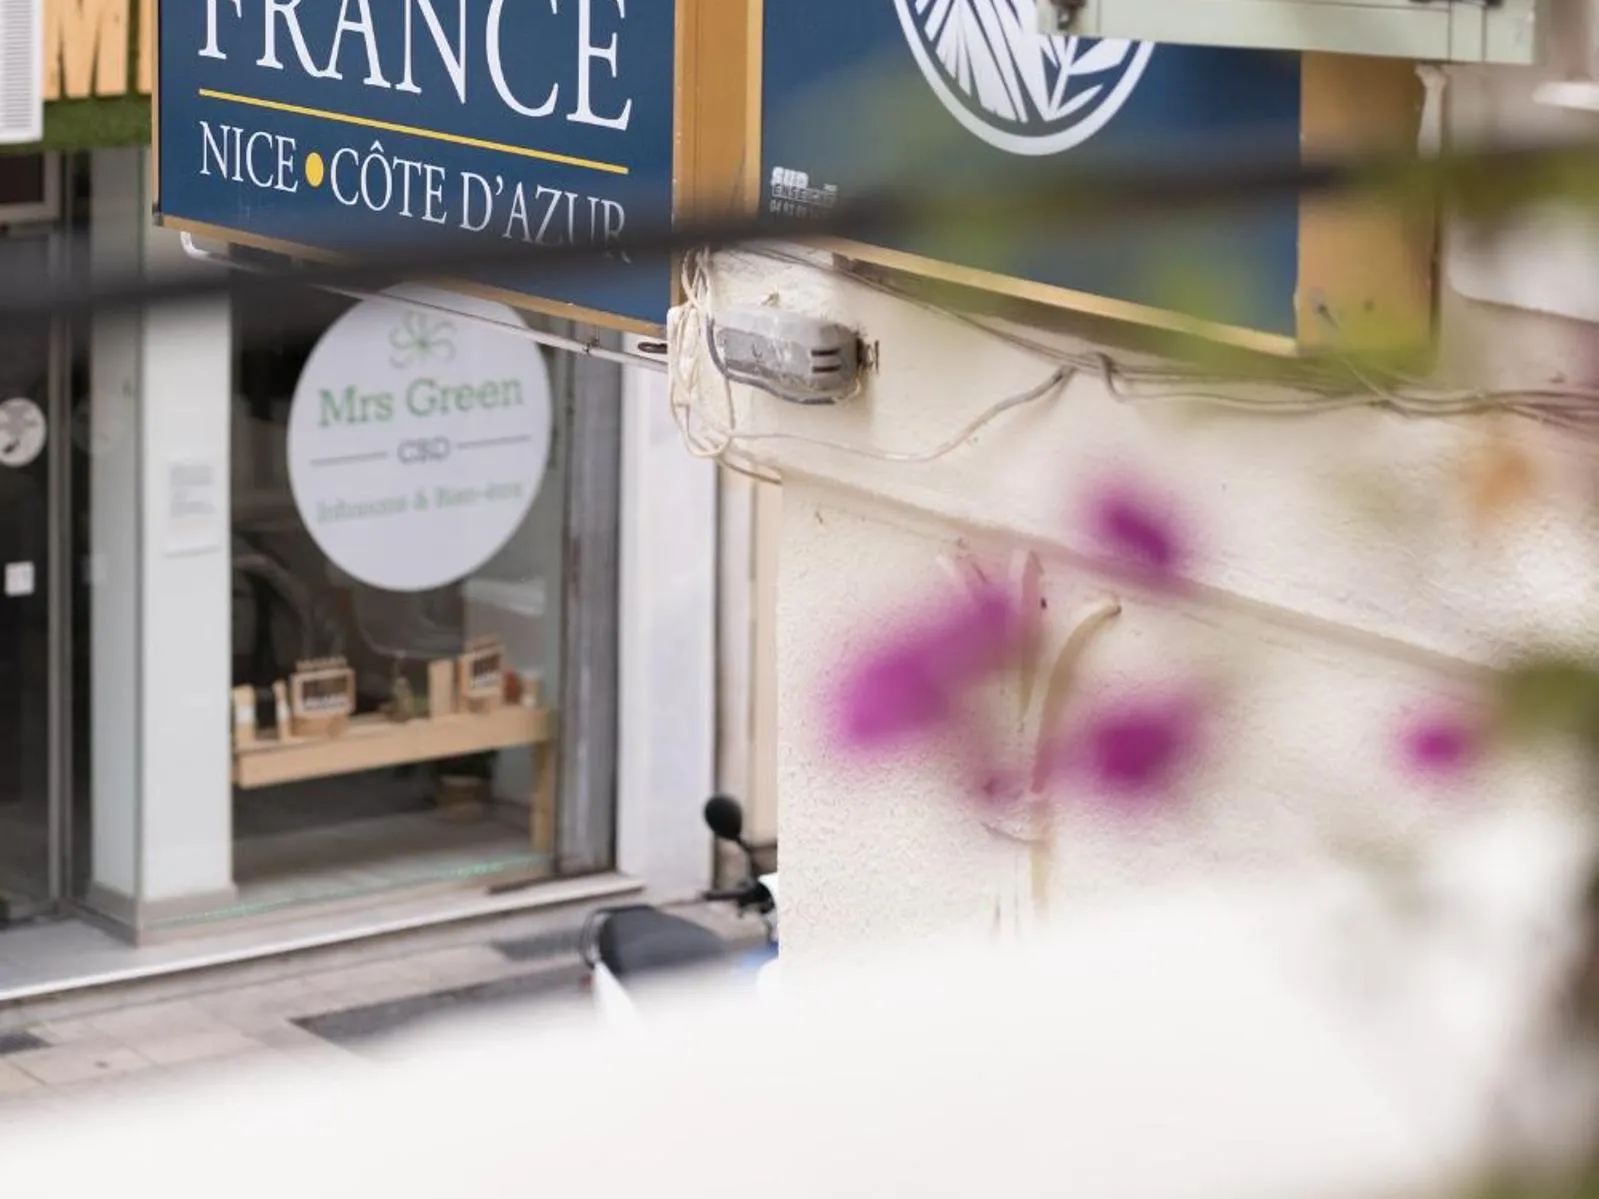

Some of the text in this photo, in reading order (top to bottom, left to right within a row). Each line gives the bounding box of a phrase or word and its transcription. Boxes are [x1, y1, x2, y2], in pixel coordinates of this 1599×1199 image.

[199, 120, 298, 193] NICE
[330, 140, 447, 224] CÔTE
[317, 376, 524, 428] Mrs Green
